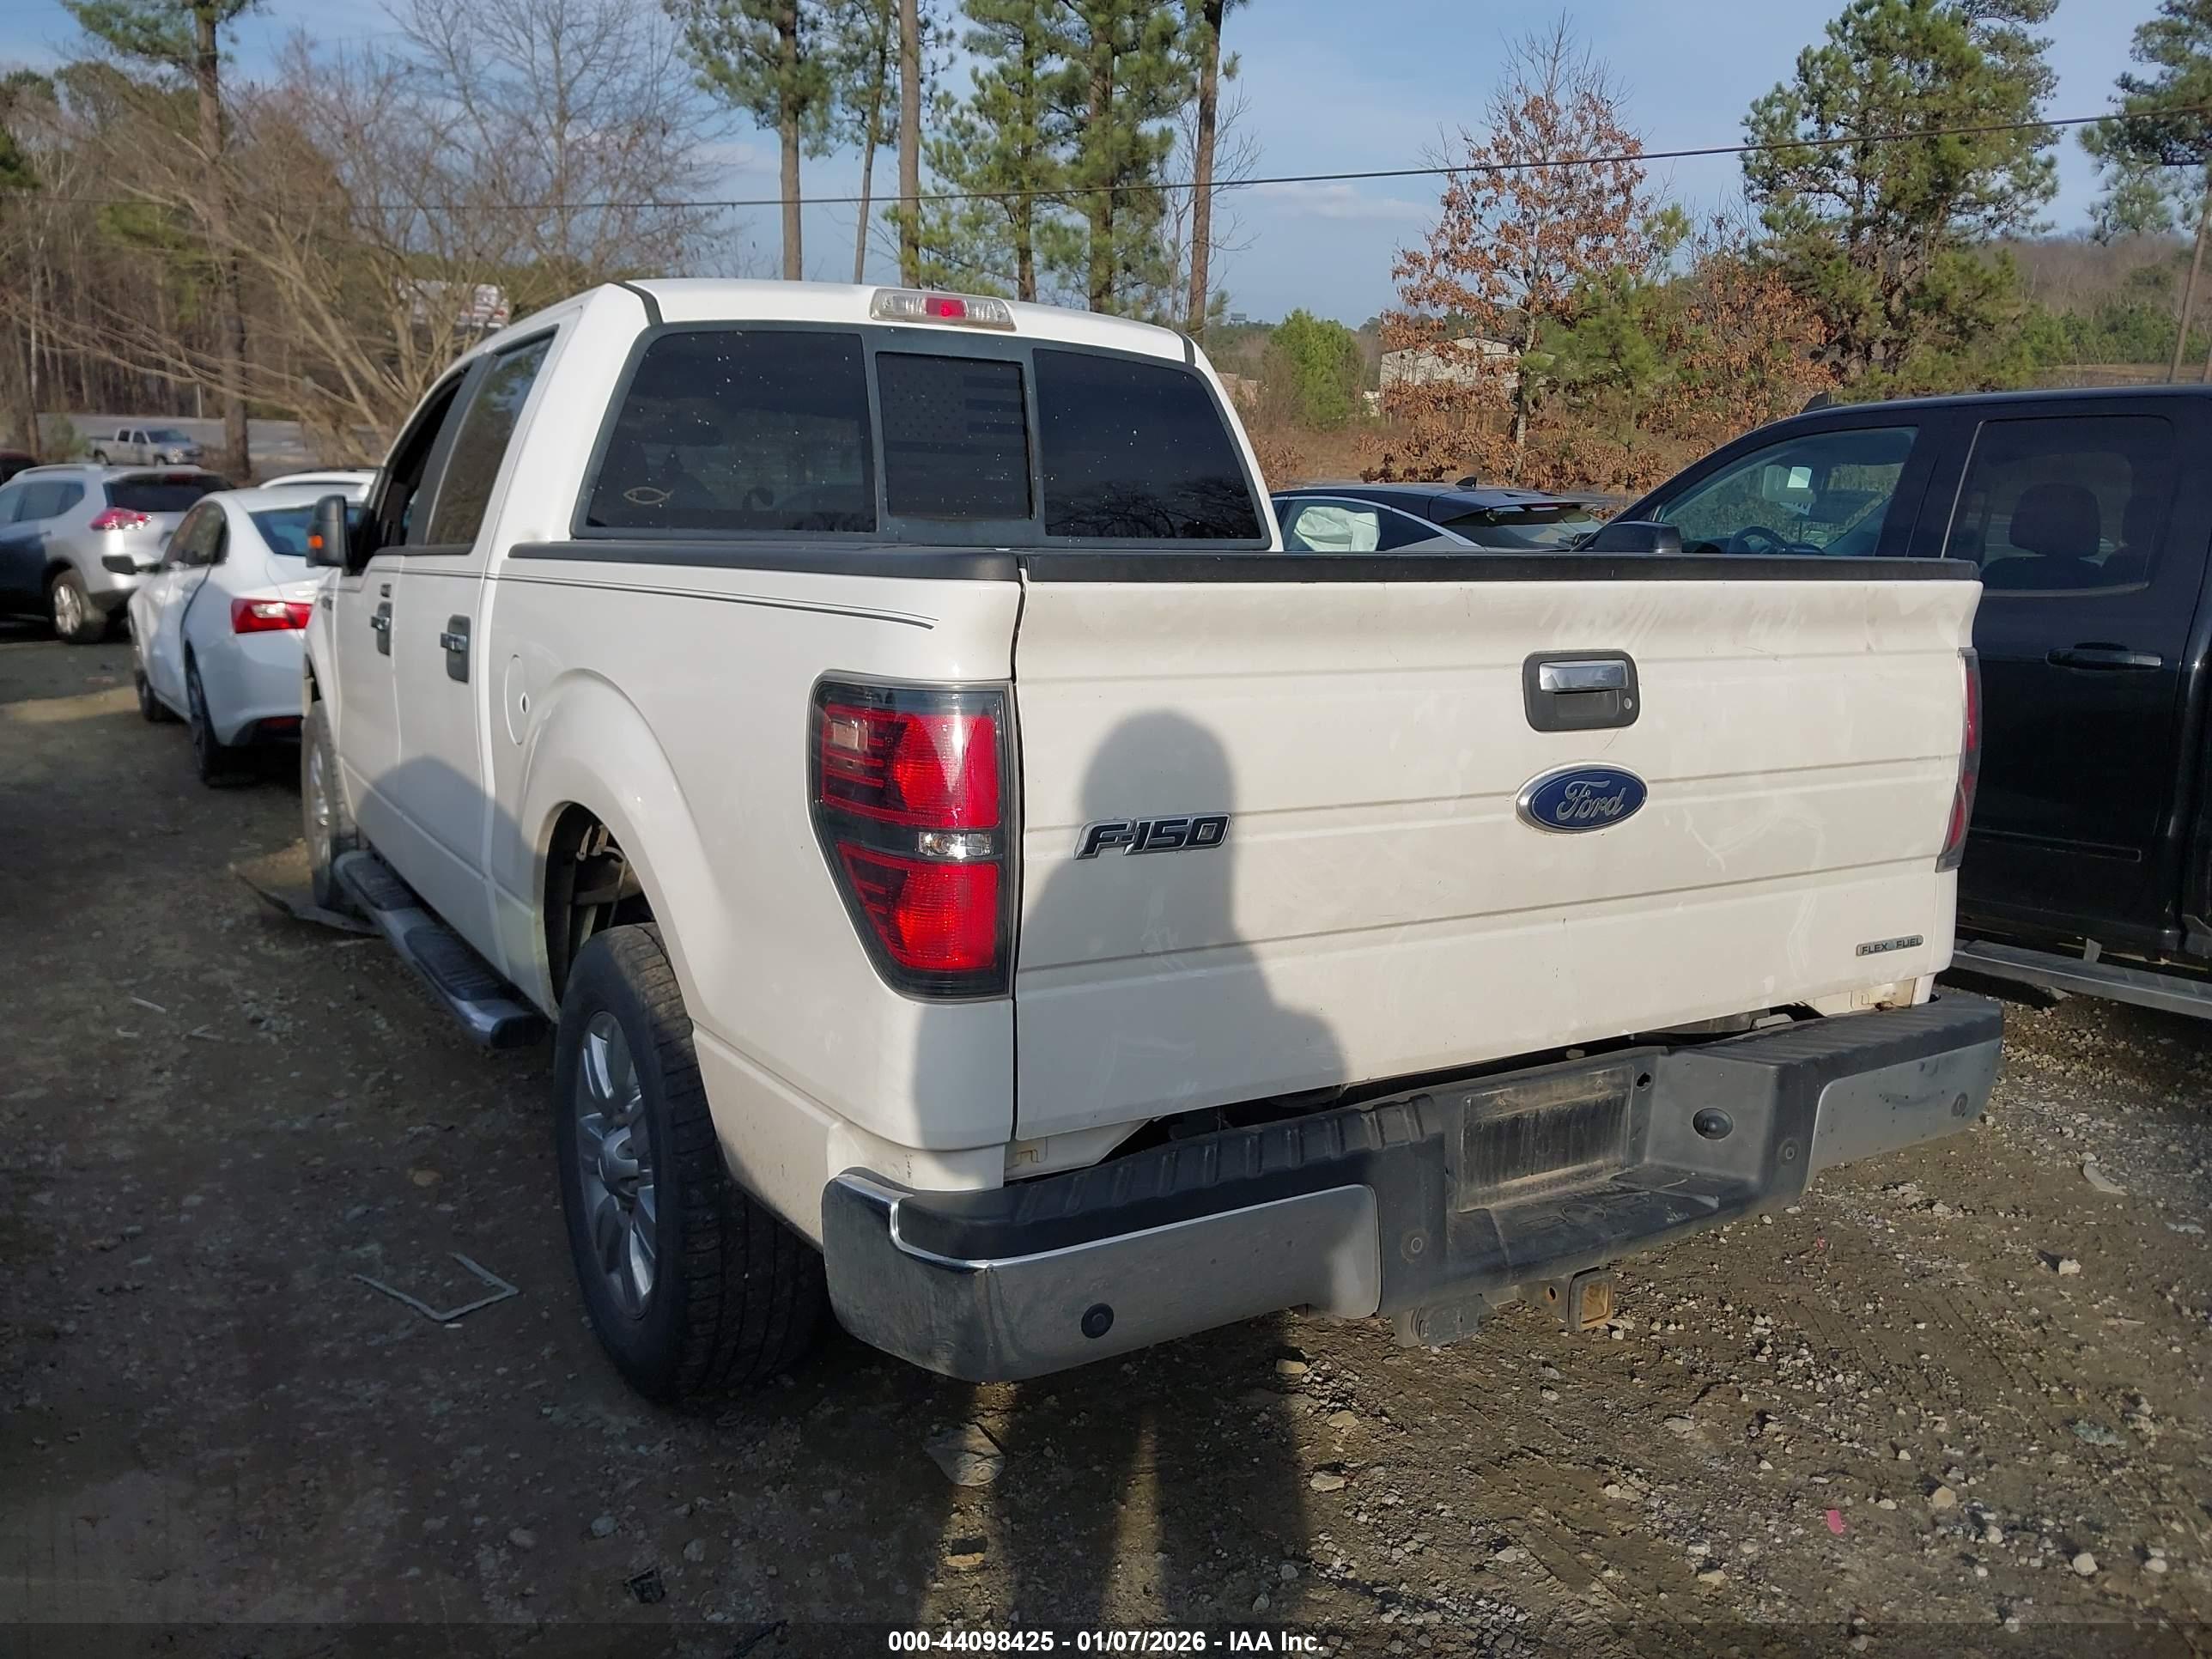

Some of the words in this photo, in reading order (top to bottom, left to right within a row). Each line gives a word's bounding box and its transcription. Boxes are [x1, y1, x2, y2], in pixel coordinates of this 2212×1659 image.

[1556, 780, 1626, 821] Ford
[1074, 811, 1231, 860] F-150
[1861, 942, 1888, 955] FLEX
[1896, 938, 1922, 949] FUEL
